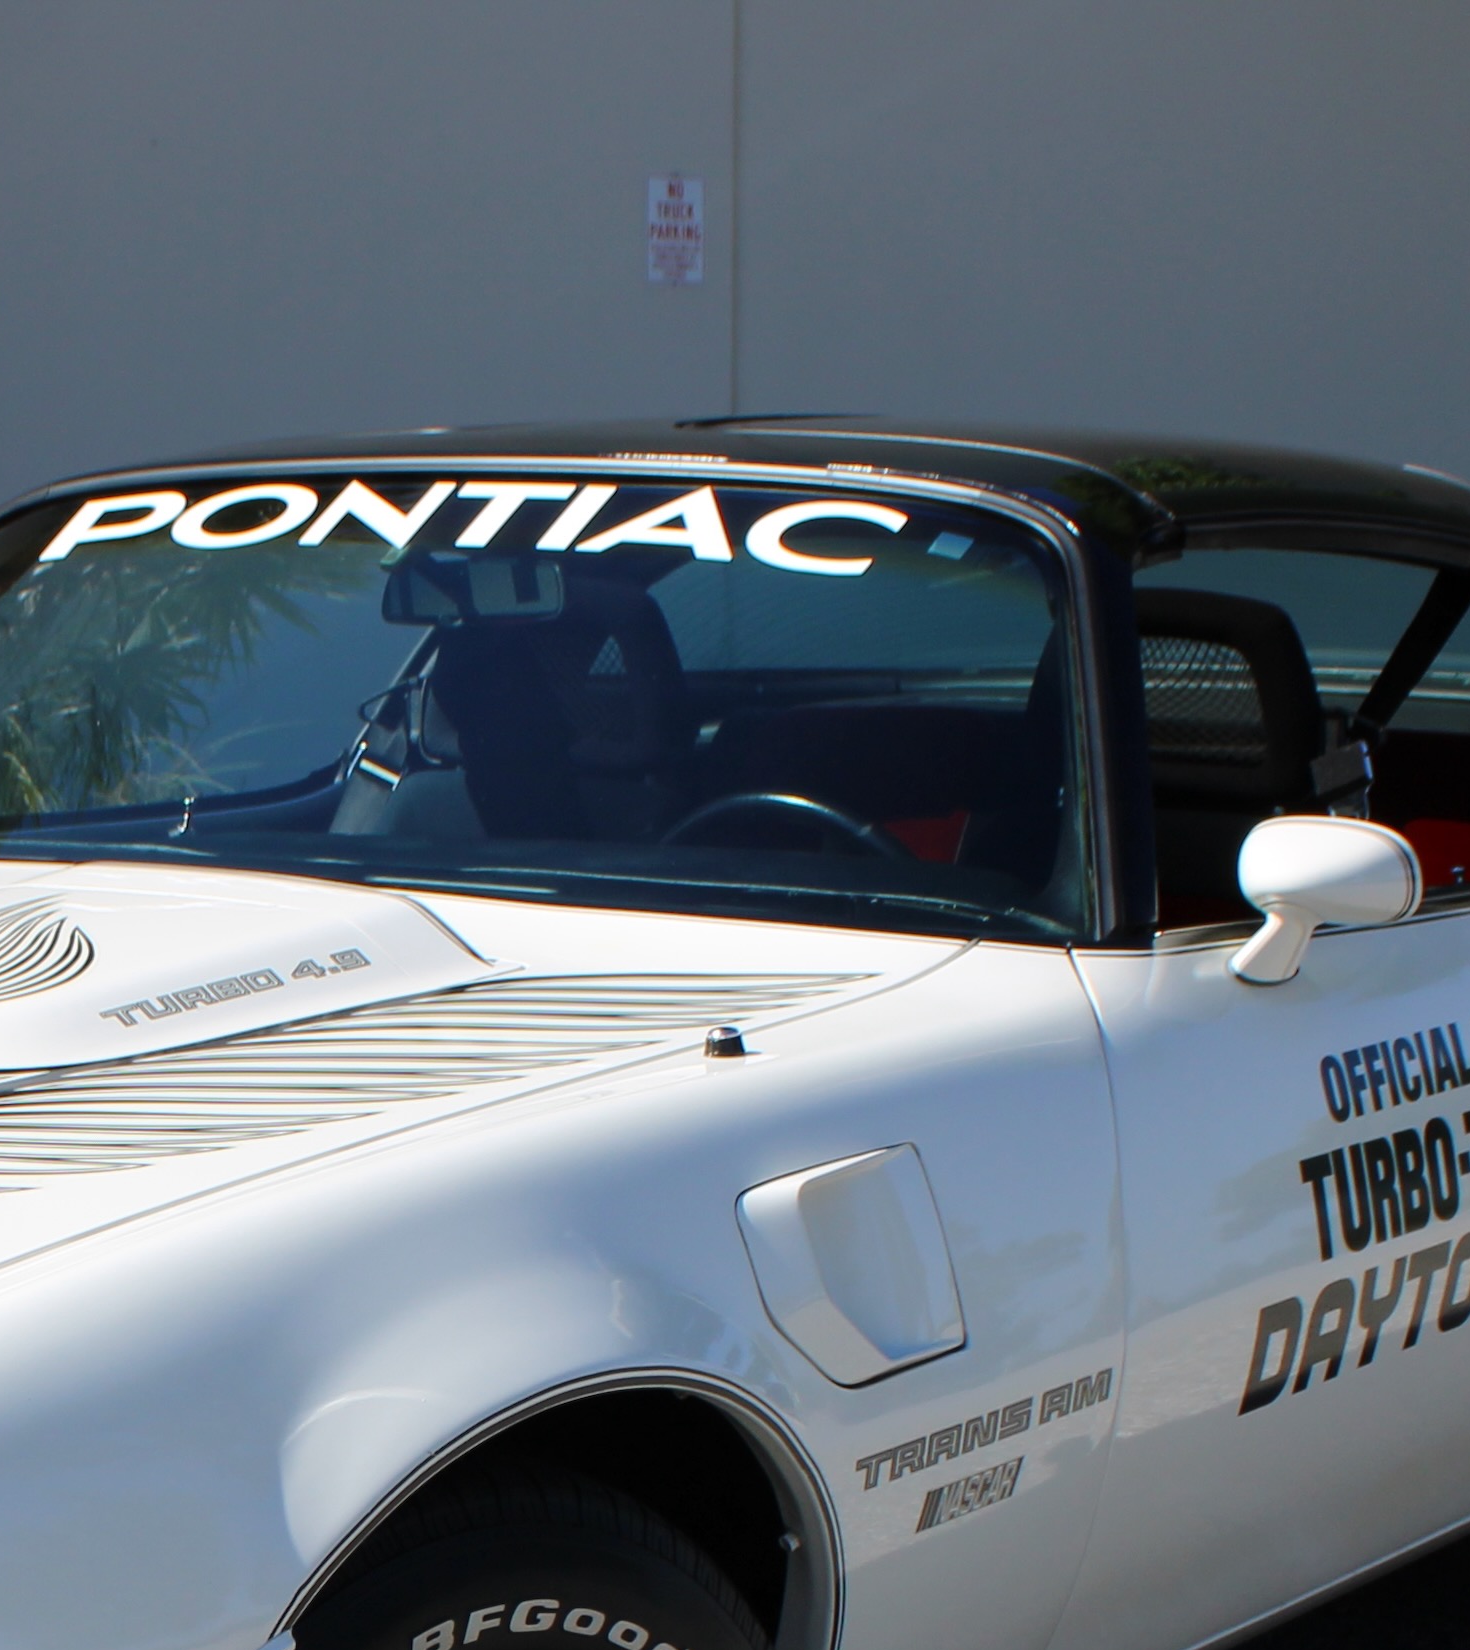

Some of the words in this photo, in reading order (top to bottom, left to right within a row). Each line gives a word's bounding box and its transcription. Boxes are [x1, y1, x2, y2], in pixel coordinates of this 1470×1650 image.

[668, 180, 684, 198] NO
[38, 480, 908, 576] PONTIAC
[99, 967, 284, 1027] TURBO
[290, 947, 371, 980] 4.9
[856, 1398, 1033, 1490] TRANS
[1039, 1368, 1112, 1425] AM
[924, 1456, 1025, 1531] NASCAR
